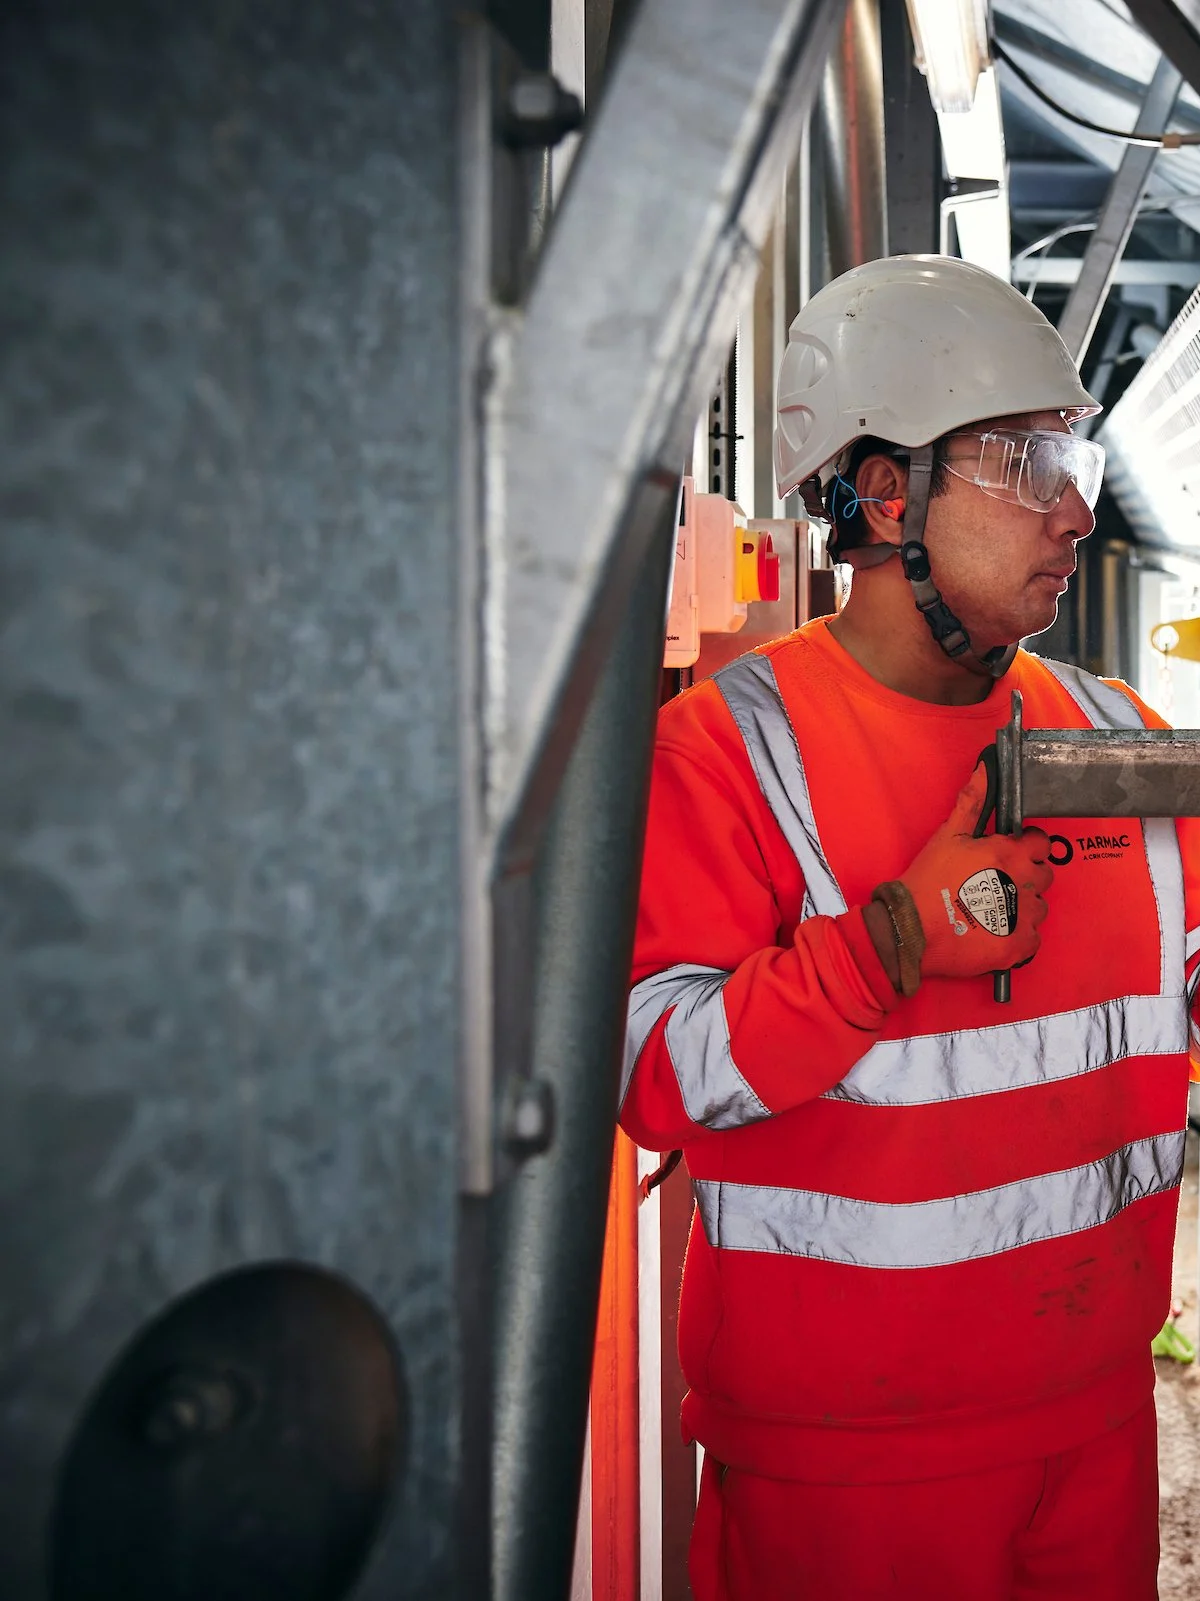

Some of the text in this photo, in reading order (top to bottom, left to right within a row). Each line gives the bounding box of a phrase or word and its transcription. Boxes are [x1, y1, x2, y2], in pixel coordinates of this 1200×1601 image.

[1076, 834, 1131, 851] TARMAC
[991, 877, 1001, 895] Grip
[998, 904, 1006, 916] Oil
[999, 917, 1007, 928] C3
